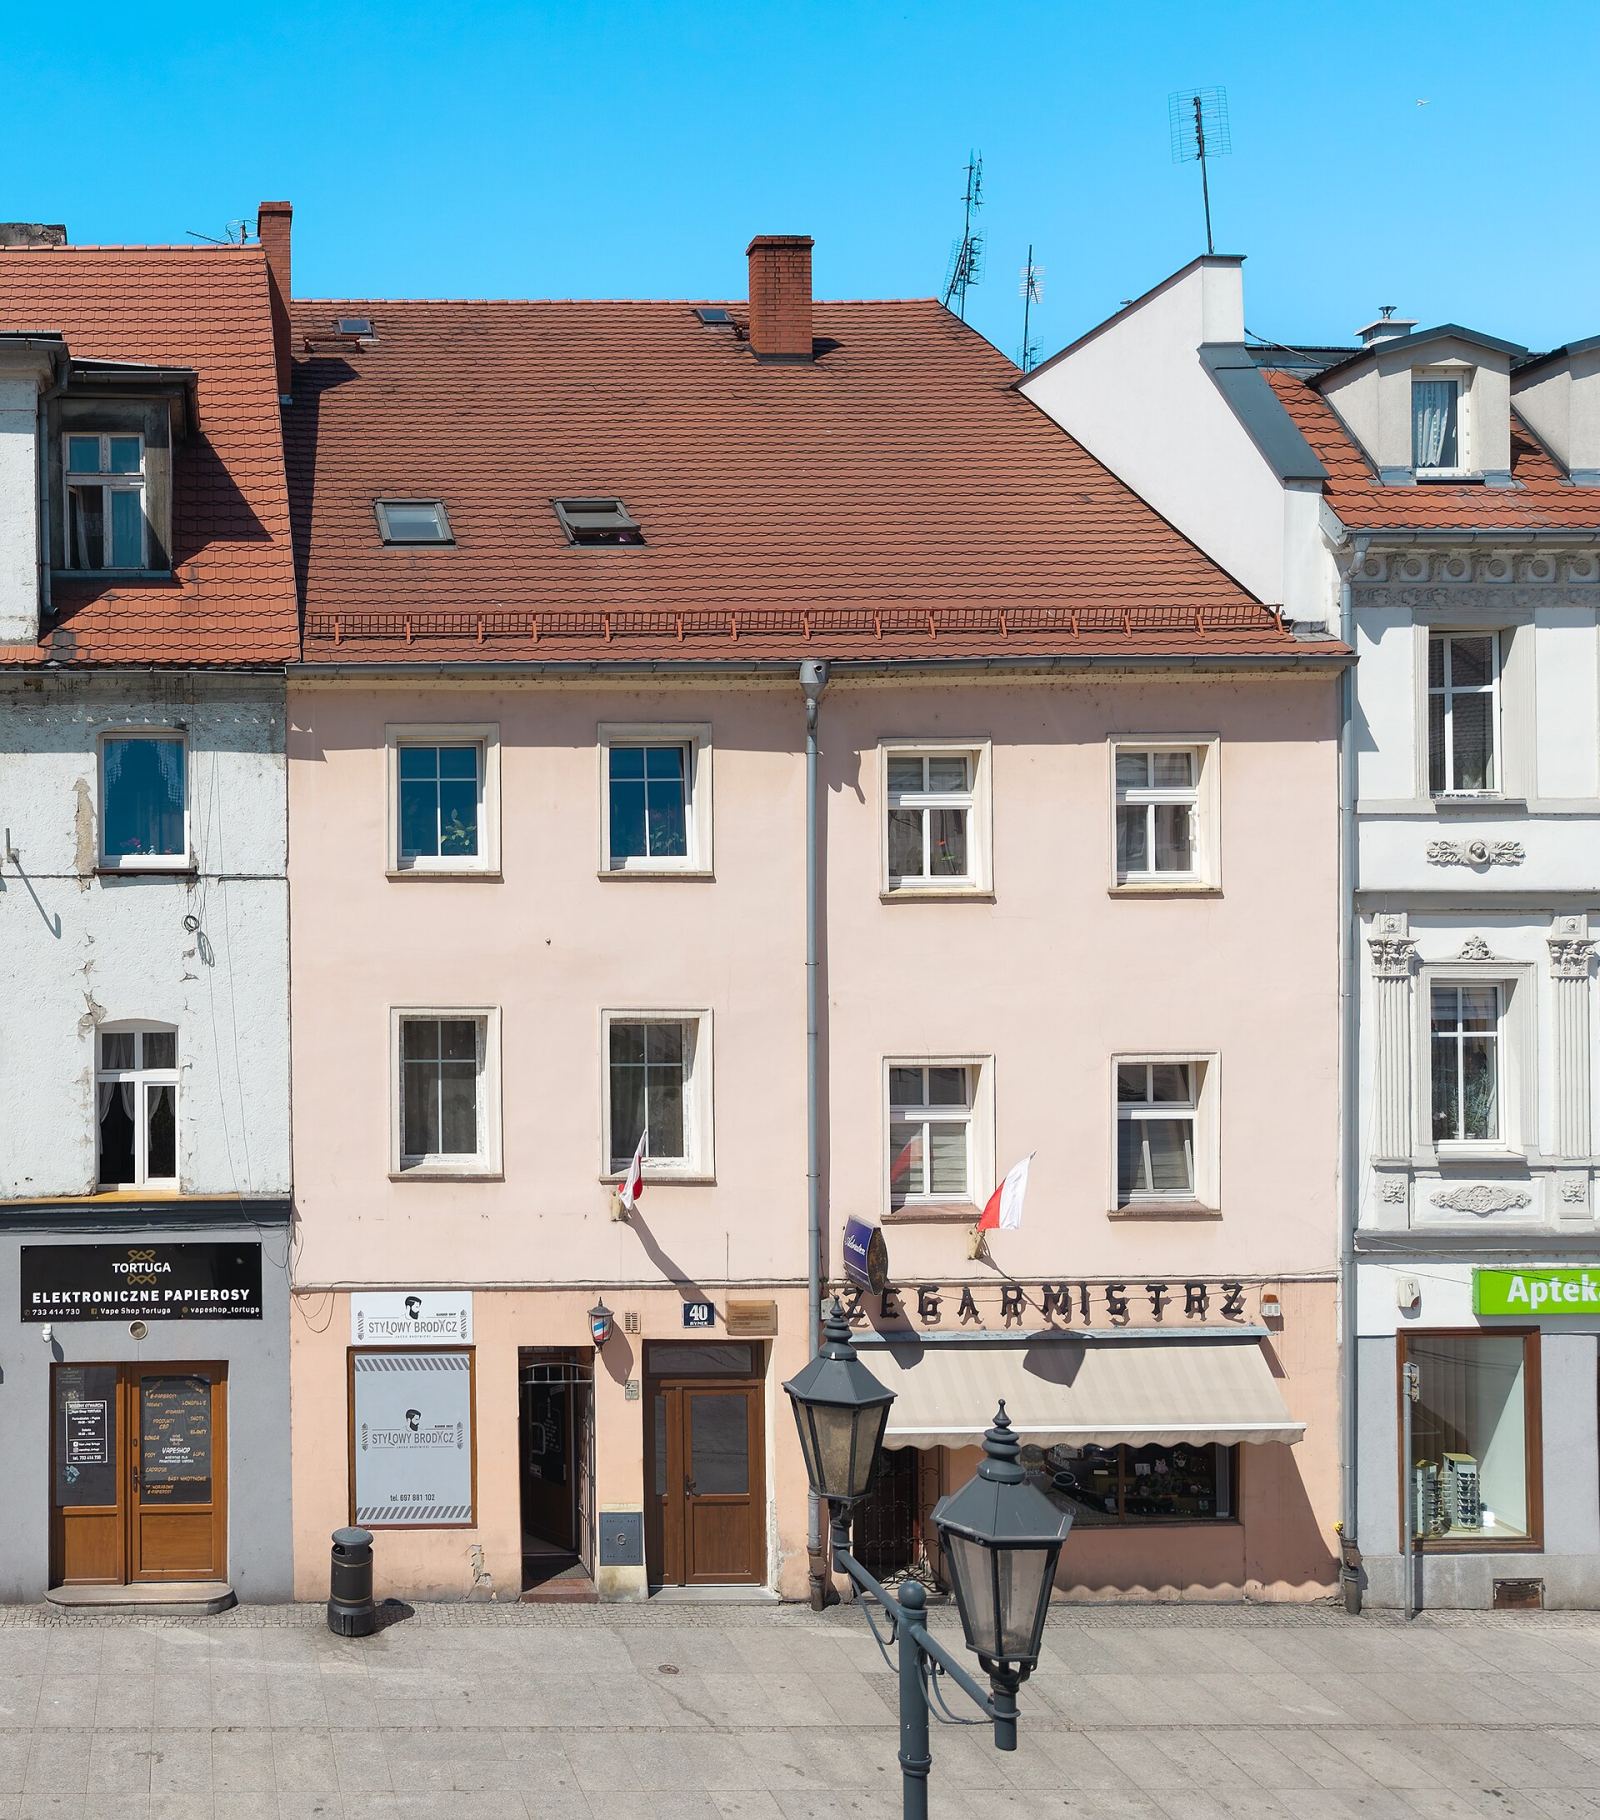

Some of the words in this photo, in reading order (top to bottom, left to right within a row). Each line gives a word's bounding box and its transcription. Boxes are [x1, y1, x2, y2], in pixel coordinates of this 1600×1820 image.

[112, 1262, 171, 1273] TORTUGA
[32, 1289, 159, 1304] ELEKTRONICZNE
[164, 1288, 250, 1301] PAPIEROSY
[1507, 1274, 1600, 1309] Aptek
[844, 1281, 1244, 1319] ZEGARMISTRZ
[121, 1307, 140, 1315] Shop
[142, 1307, 171, 1315] Tortuga
[190, 1306, 259, 1314] vapeshop_tortuga
[689, 1304, 708, 1321] 40
[161, 1446, 191, 1454] VAPESHOP
